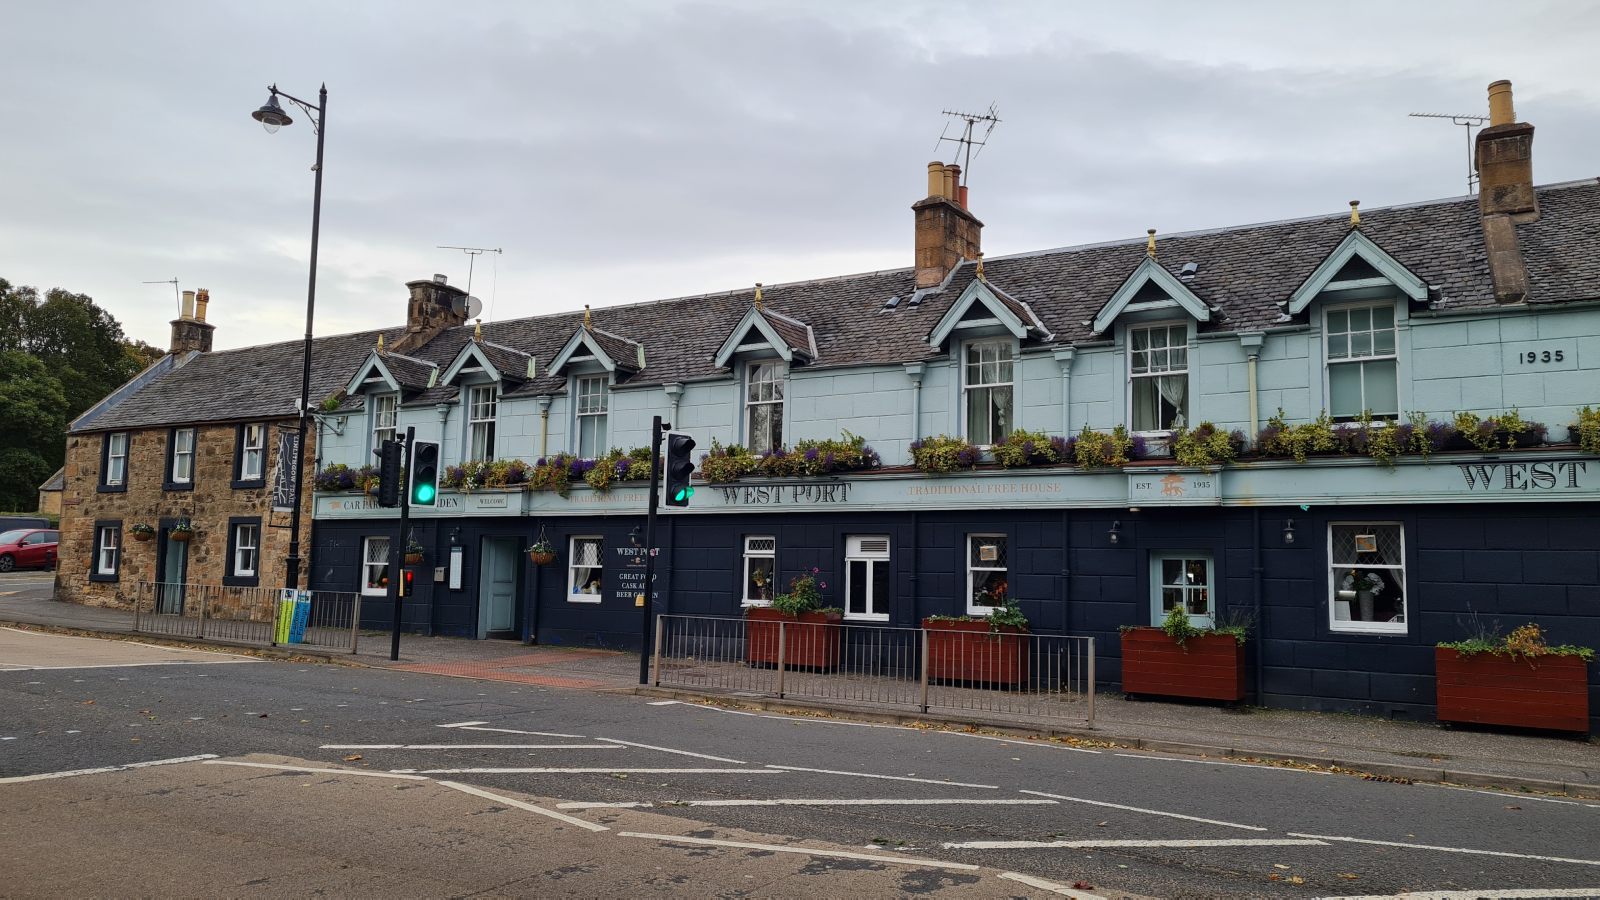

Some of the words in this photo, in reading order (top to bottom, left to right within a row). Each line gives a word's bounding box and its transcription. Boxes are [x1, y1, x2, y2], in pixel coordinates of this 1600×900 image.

[1519, 350, 1564, 365] 1935
[1457, 461, 1587, 491] WEST
[909, 484, 984, 495] TRADITIONAL
[987, 482, 1017, 494] FREE
[1020, 482, 1062, 493] HOUSE
[1136, 482, 1153, 490] EST.
[1193, 481, 1211, 489] 1935
[720, 485, 785, 505] WEST
[791, 483, 852, 503] PORT
[344, 500, 360, 510] CAR
[437, 497, 459, 508] DEN
[616, 547, 639, 556] WEST
